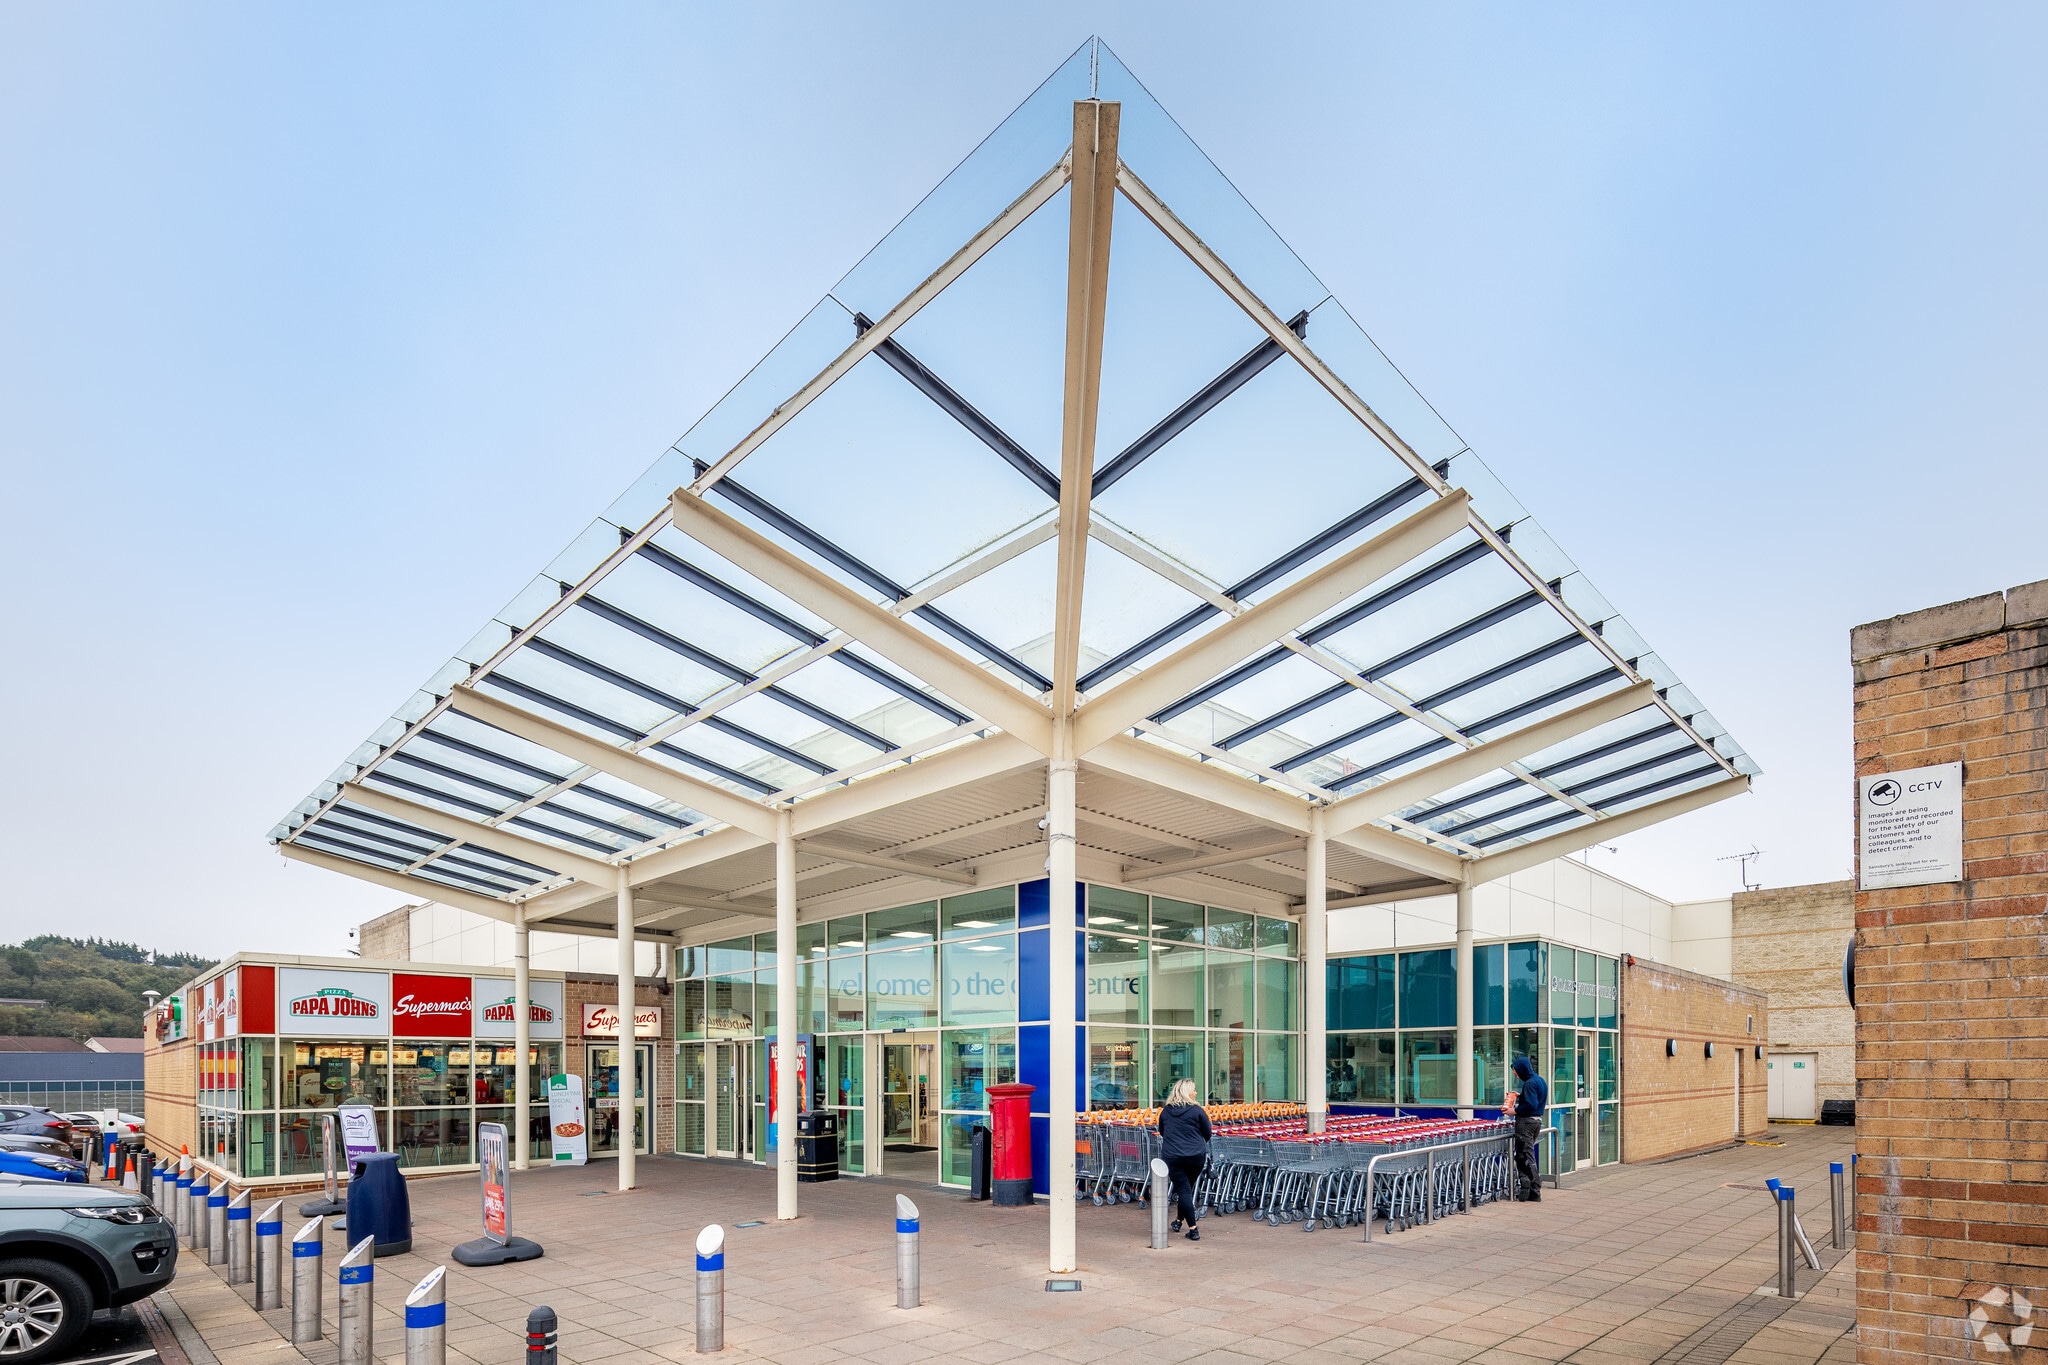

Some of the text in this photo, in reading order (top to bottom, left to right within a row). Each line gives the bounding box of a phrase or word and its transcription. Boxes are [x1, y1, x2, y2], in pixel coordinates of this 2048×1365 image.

[1908, 780, 1942, 793] CCTV
[1868, 811, 1893, 819] Images
[1908, 806, 1929, 814] being
[1868, 816, 1904, 826] monitored
[1920, 809, 1954, 819] recorded
[1868, 828, 1920, 840] customers and
[1893, 822, 1916, 830] safety
[1868, 838, 1907, 847] colleagues,
[1868, 846, 1891, 854] detect
[822, 972, 931, 996] elome
[966, 972, 1005, 996] the
[1088, 977, 1139, 995] entre
[292, 998, 330, 1015] PAPA
[393, 994, 472, 1019] Supermac's
[484, 1004, 515, 1021] PAPA
[586, 1007, 657, 1031] Supmac's
